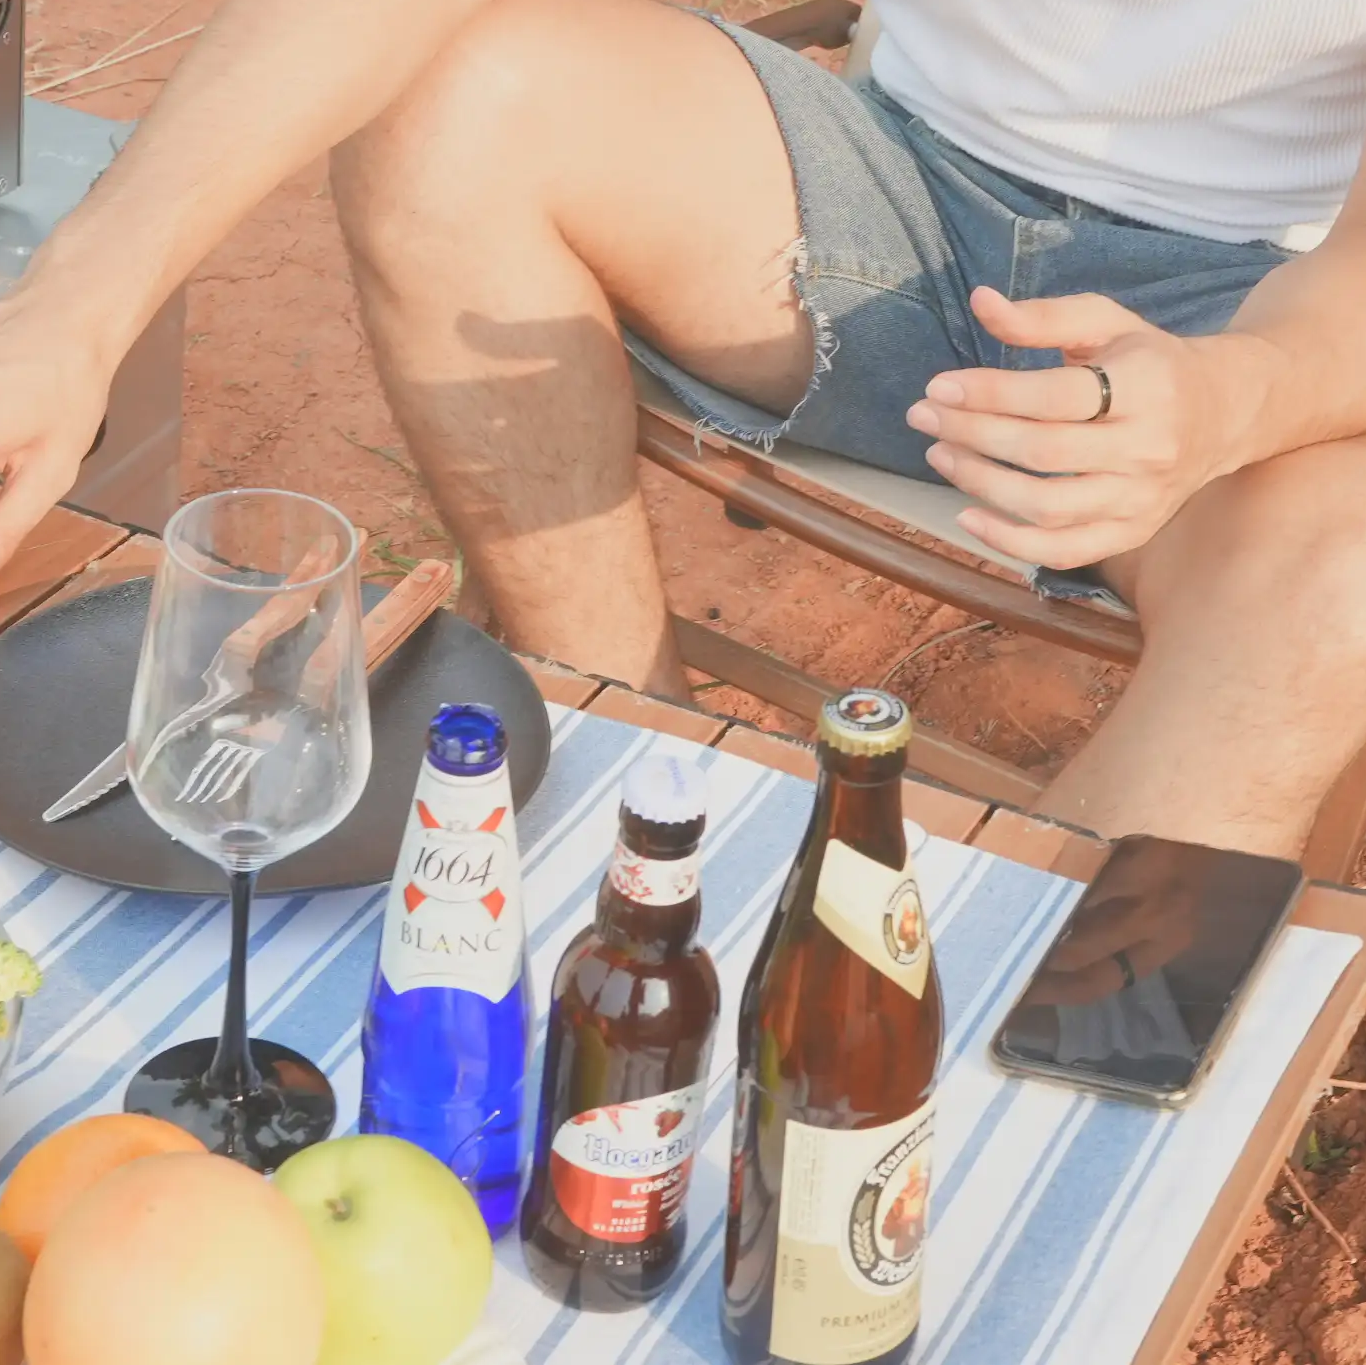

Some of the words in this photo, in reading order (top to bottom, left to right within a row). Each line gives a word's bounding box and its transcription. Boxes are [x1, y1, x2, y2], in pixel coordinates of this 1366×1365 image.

[414, 846, 495, 887] 1664
[400, 920, 503, 956] BLANC
[820, 1299, 900, 1328] PREMIUM
